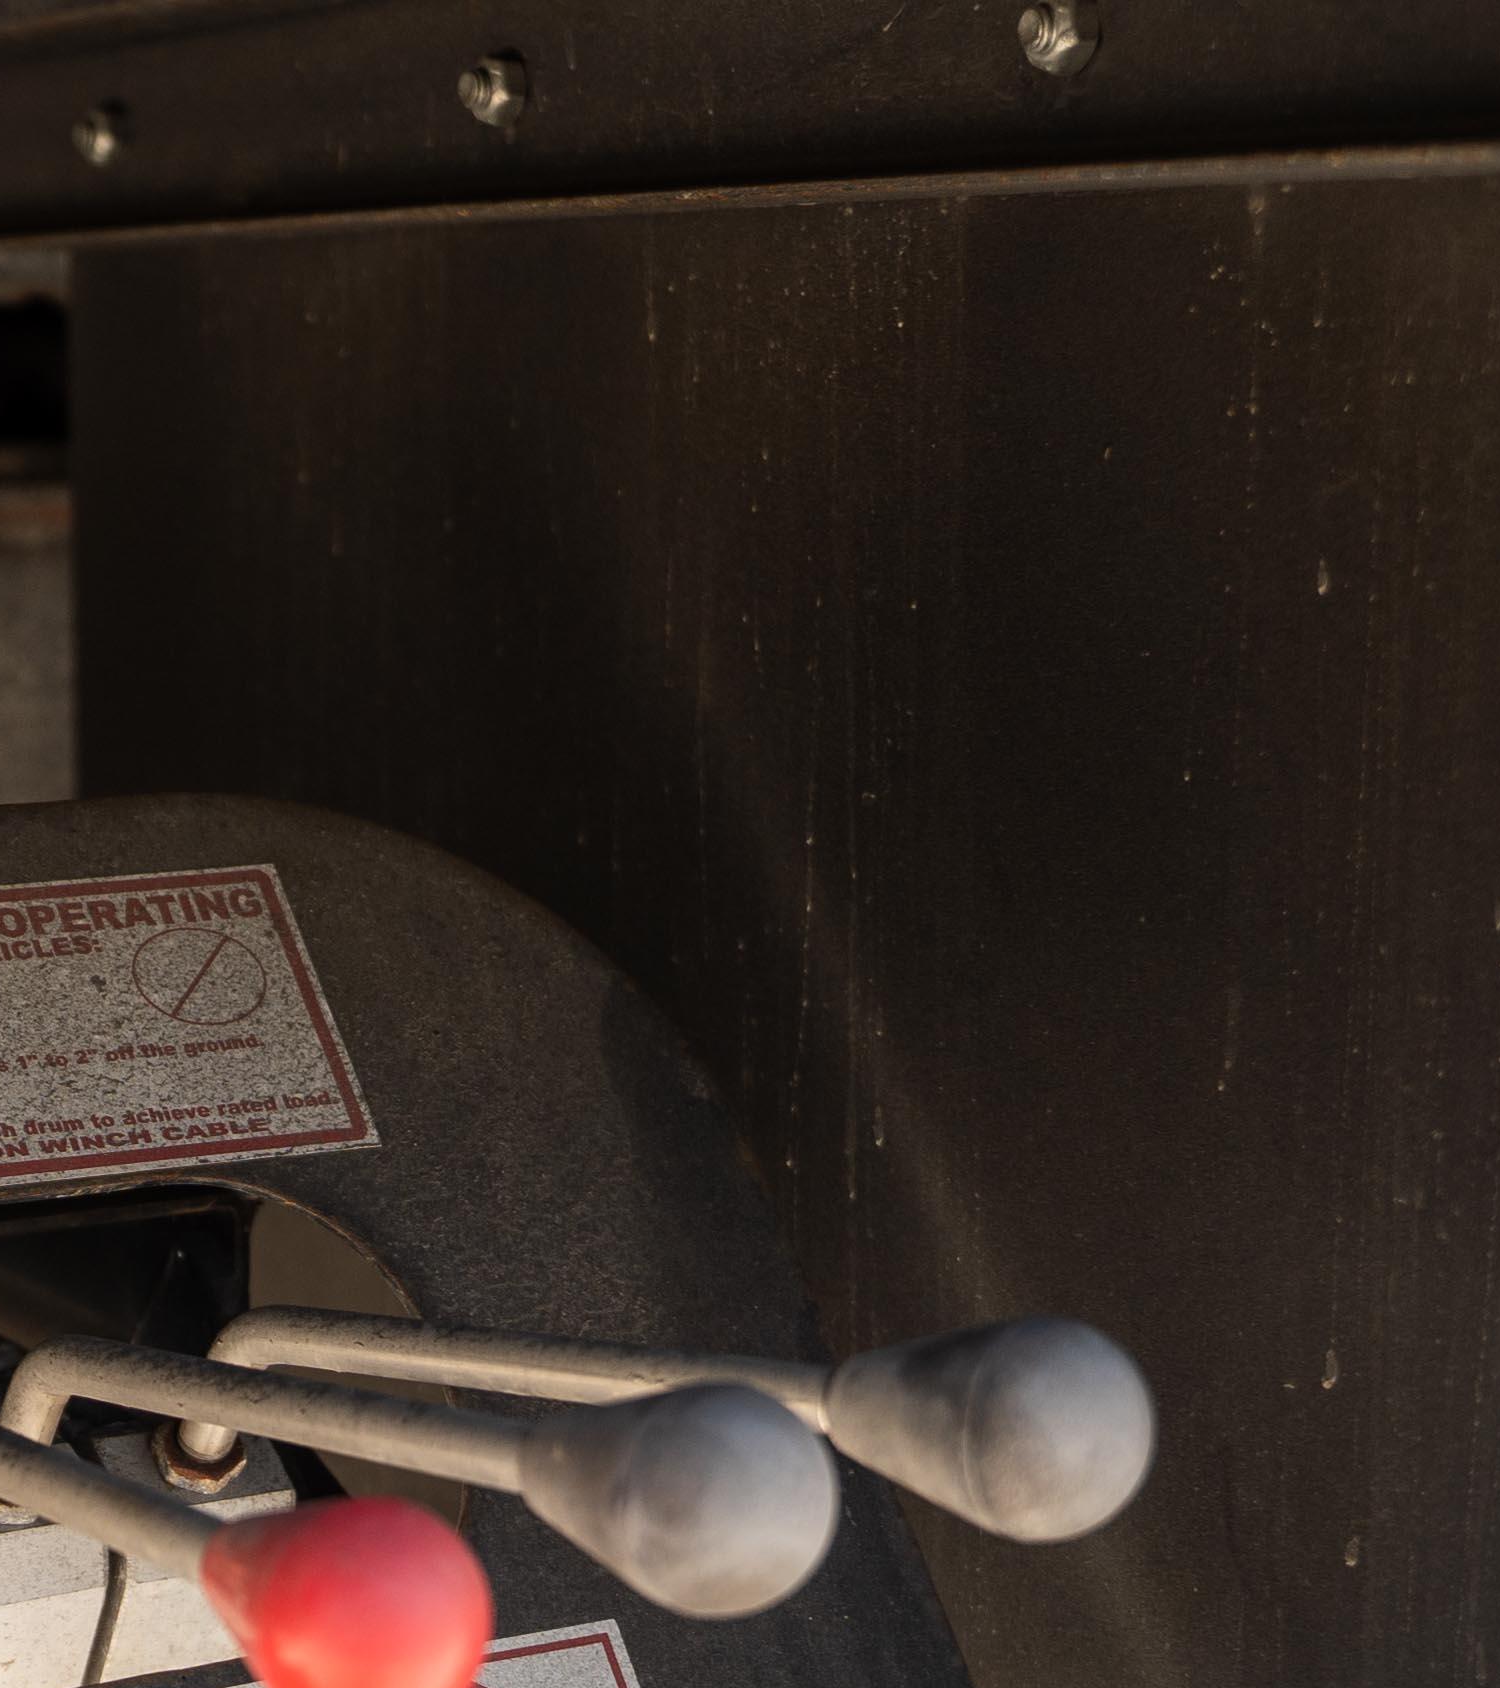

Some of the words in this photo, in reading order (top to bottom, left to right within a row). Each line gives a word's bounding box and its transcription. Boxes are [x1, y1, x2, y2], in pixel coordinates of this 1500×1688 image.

[42, 1051, 70, 1067] to
[102, 1045, 136, 1061] off
[136, 1041, 174, 1058] the
[181, 1033, 267, 1057] ground.
[20, 1115, 83, 1135] drum
[89, 1112, 117, 1128] to
[119, 1102, 211, 1125] achieve
[214, 1096, 277, 1115] rated
[38, 1128, 153, 1154] WINCH
[159, 1116, 272, 1141] CABLE
